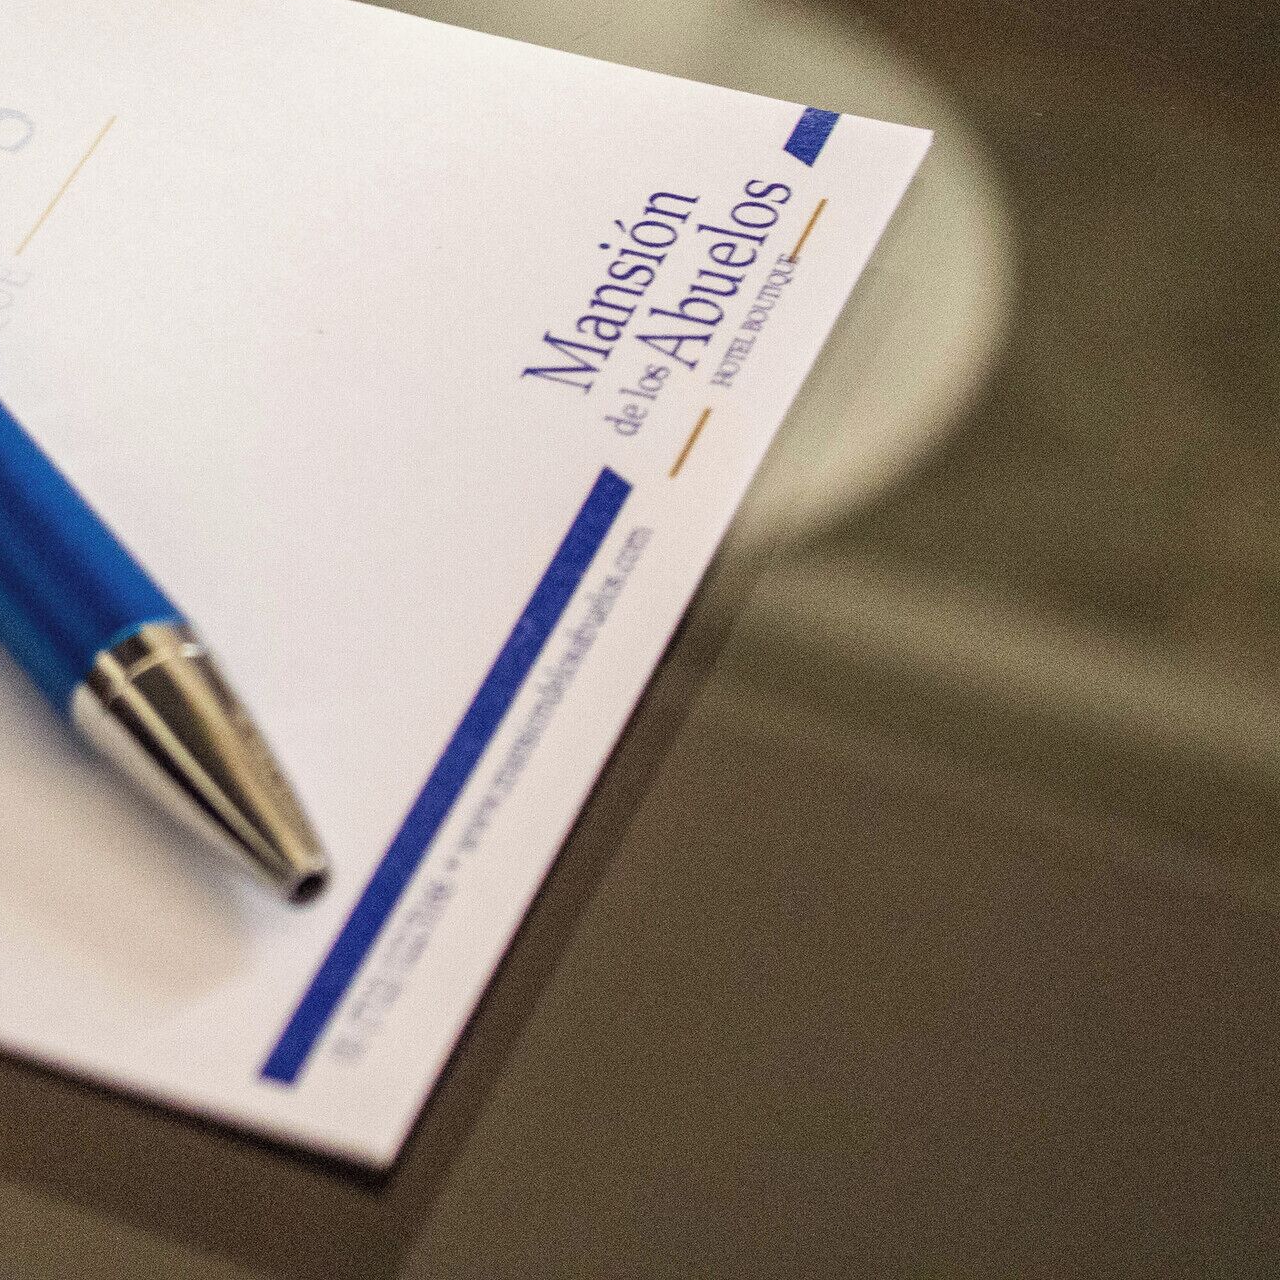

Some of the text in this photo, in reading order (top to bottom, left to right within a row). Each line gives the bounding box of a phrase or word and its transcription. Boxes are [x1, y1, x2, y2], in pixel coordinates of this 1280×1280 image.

[521, 190, 700, 396] Mansión
[604, 178, 793, 437] de los Abuelos
[709, 252, 801, 388] HOTEL BOUTIQUE
